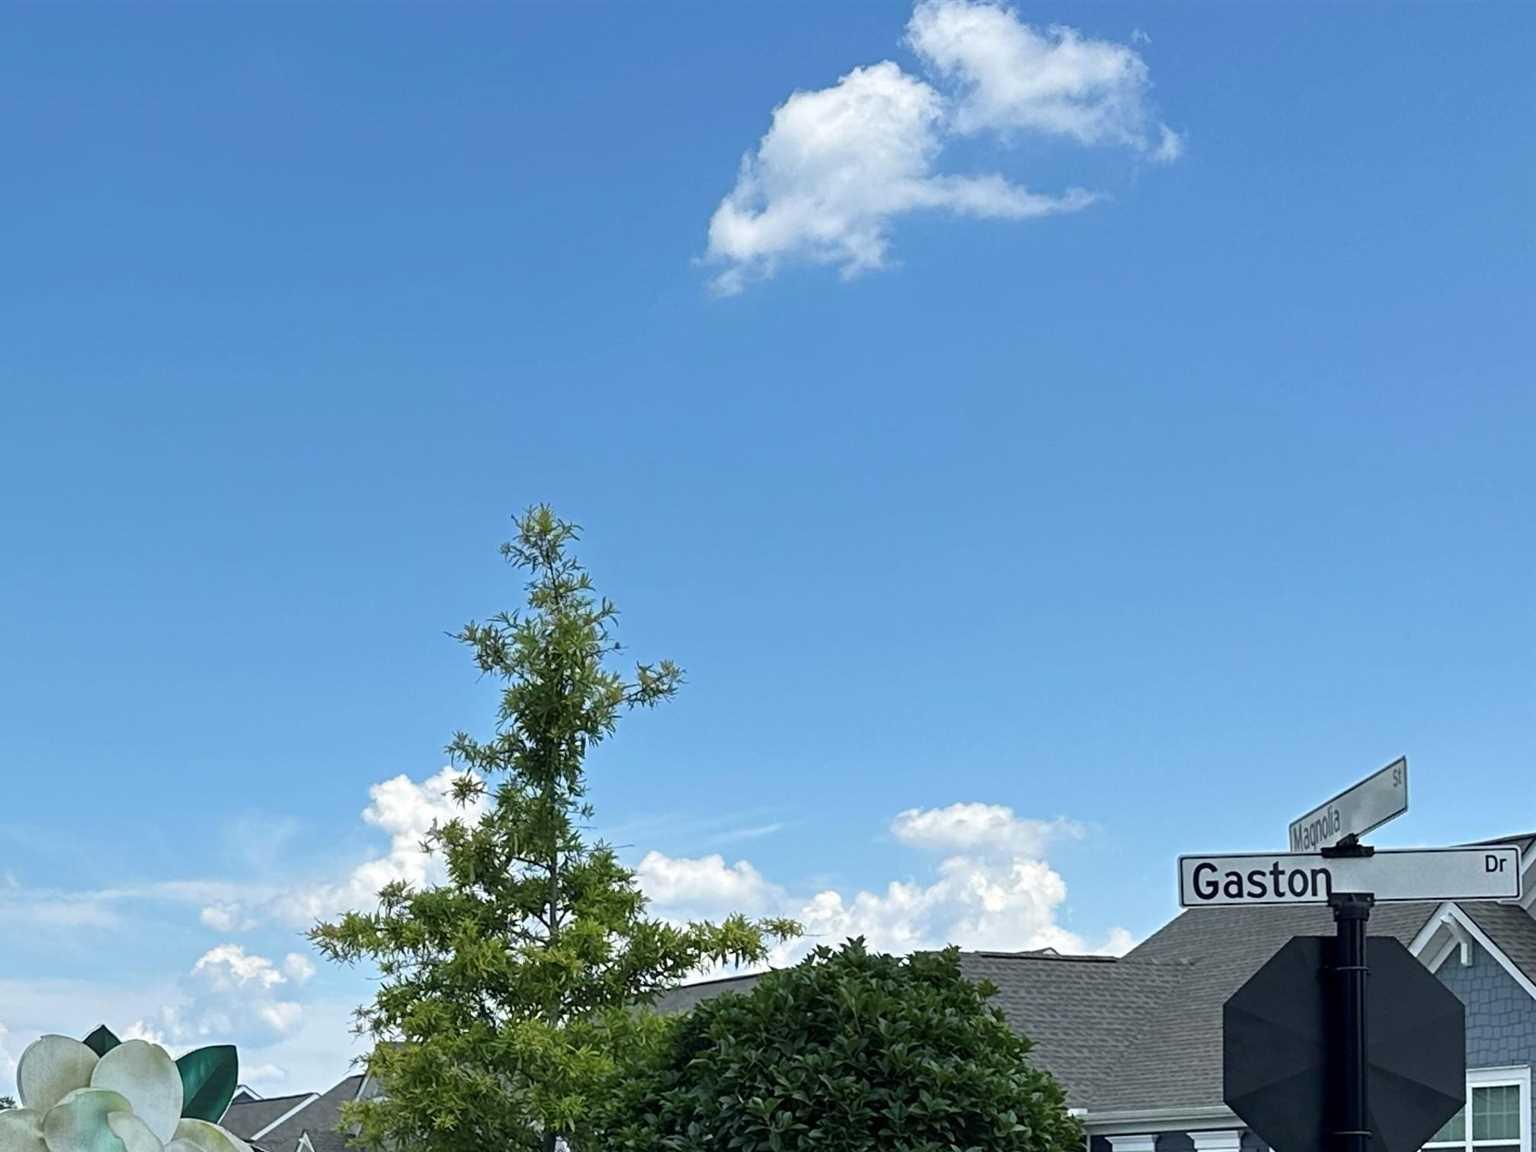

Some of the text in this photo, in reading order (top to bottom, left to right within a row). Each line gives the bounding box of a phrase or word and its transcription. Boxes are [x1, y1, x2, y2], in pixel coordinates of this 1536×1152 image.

[1293, 768, 1402, 852] Magnolia St
[1192, 855, 1507, 900] Gaston Dr
